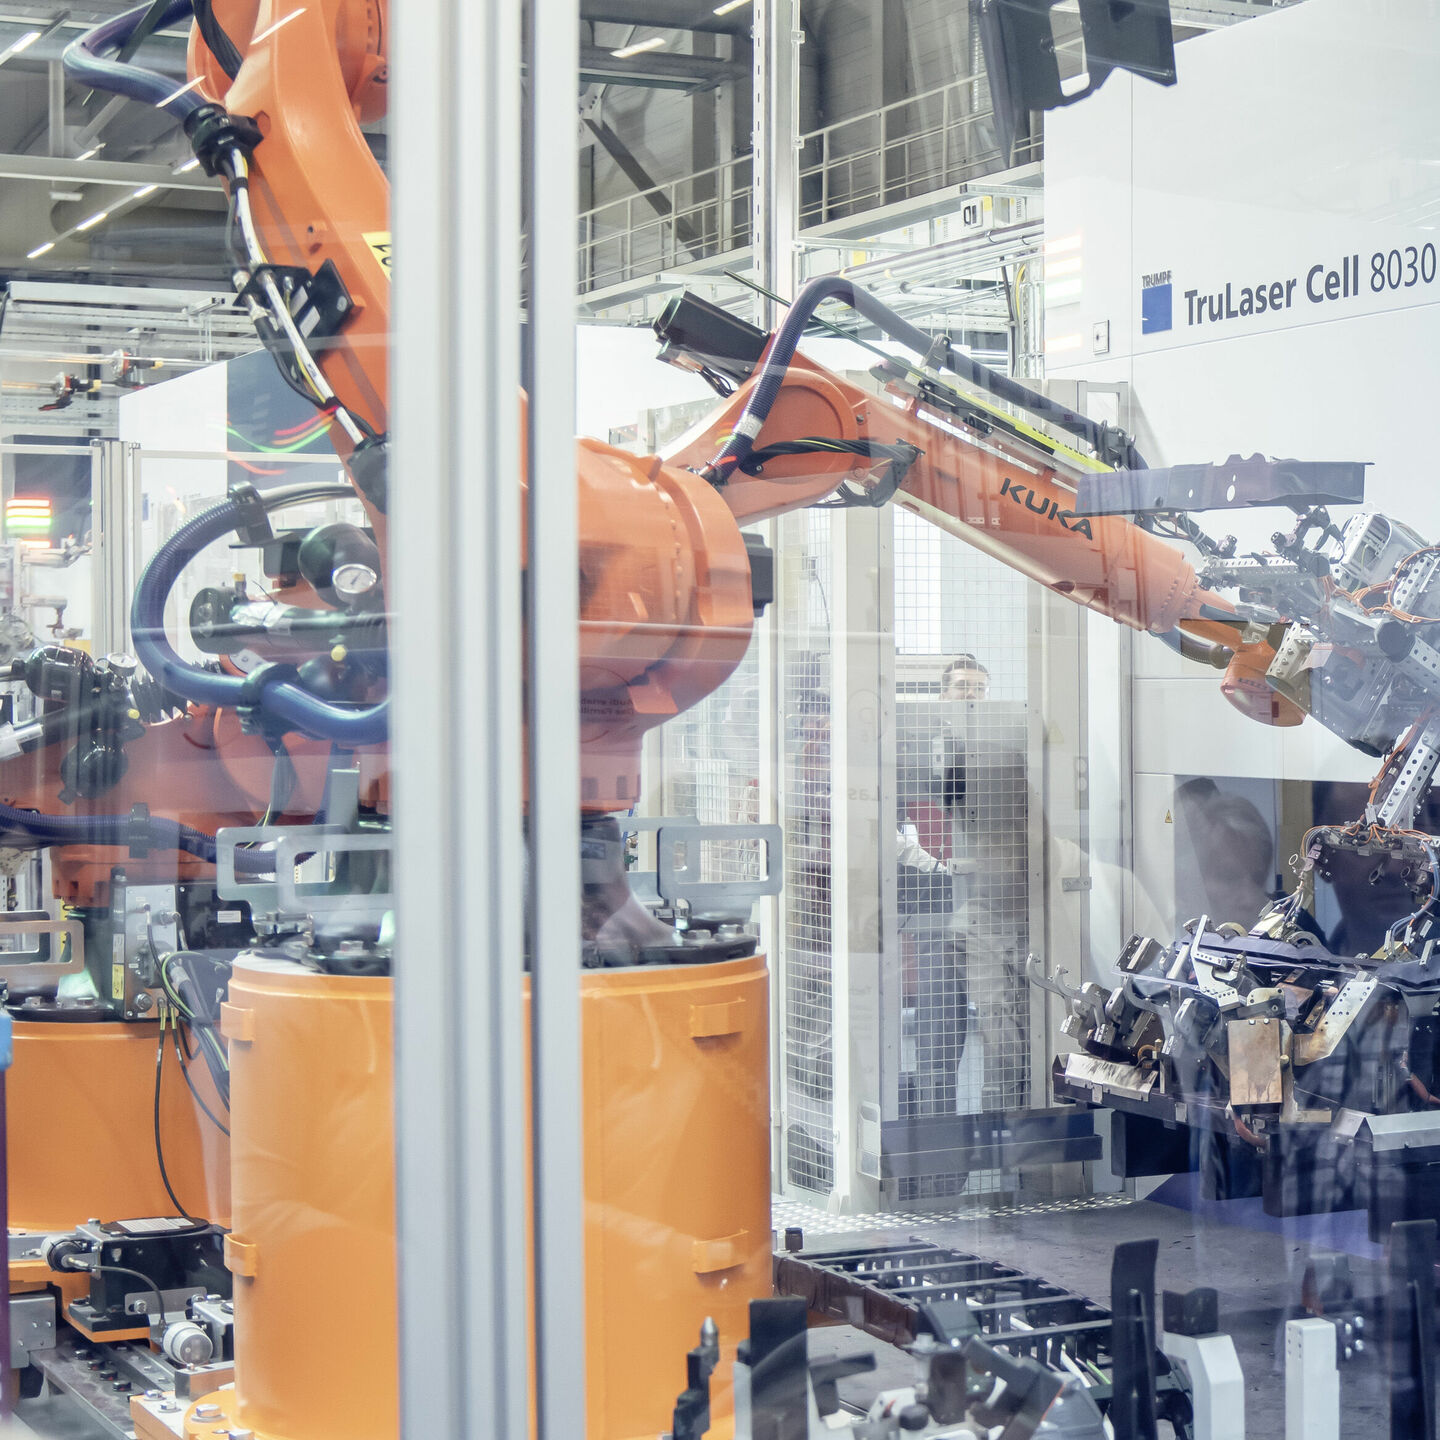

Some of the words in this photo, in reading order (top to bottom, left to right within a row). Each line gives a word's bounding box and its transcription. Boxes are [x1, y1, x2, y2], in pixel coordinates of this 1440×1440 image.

[1142, 270, 1172, 288] TRUMPF
[1184, 277, 1297, 326] TruLaser
[1306, 254, 1359, 303] Cell
[1370, 242, 1437, 293] 8030
[1000, 477, 1093, 541] KUKA
